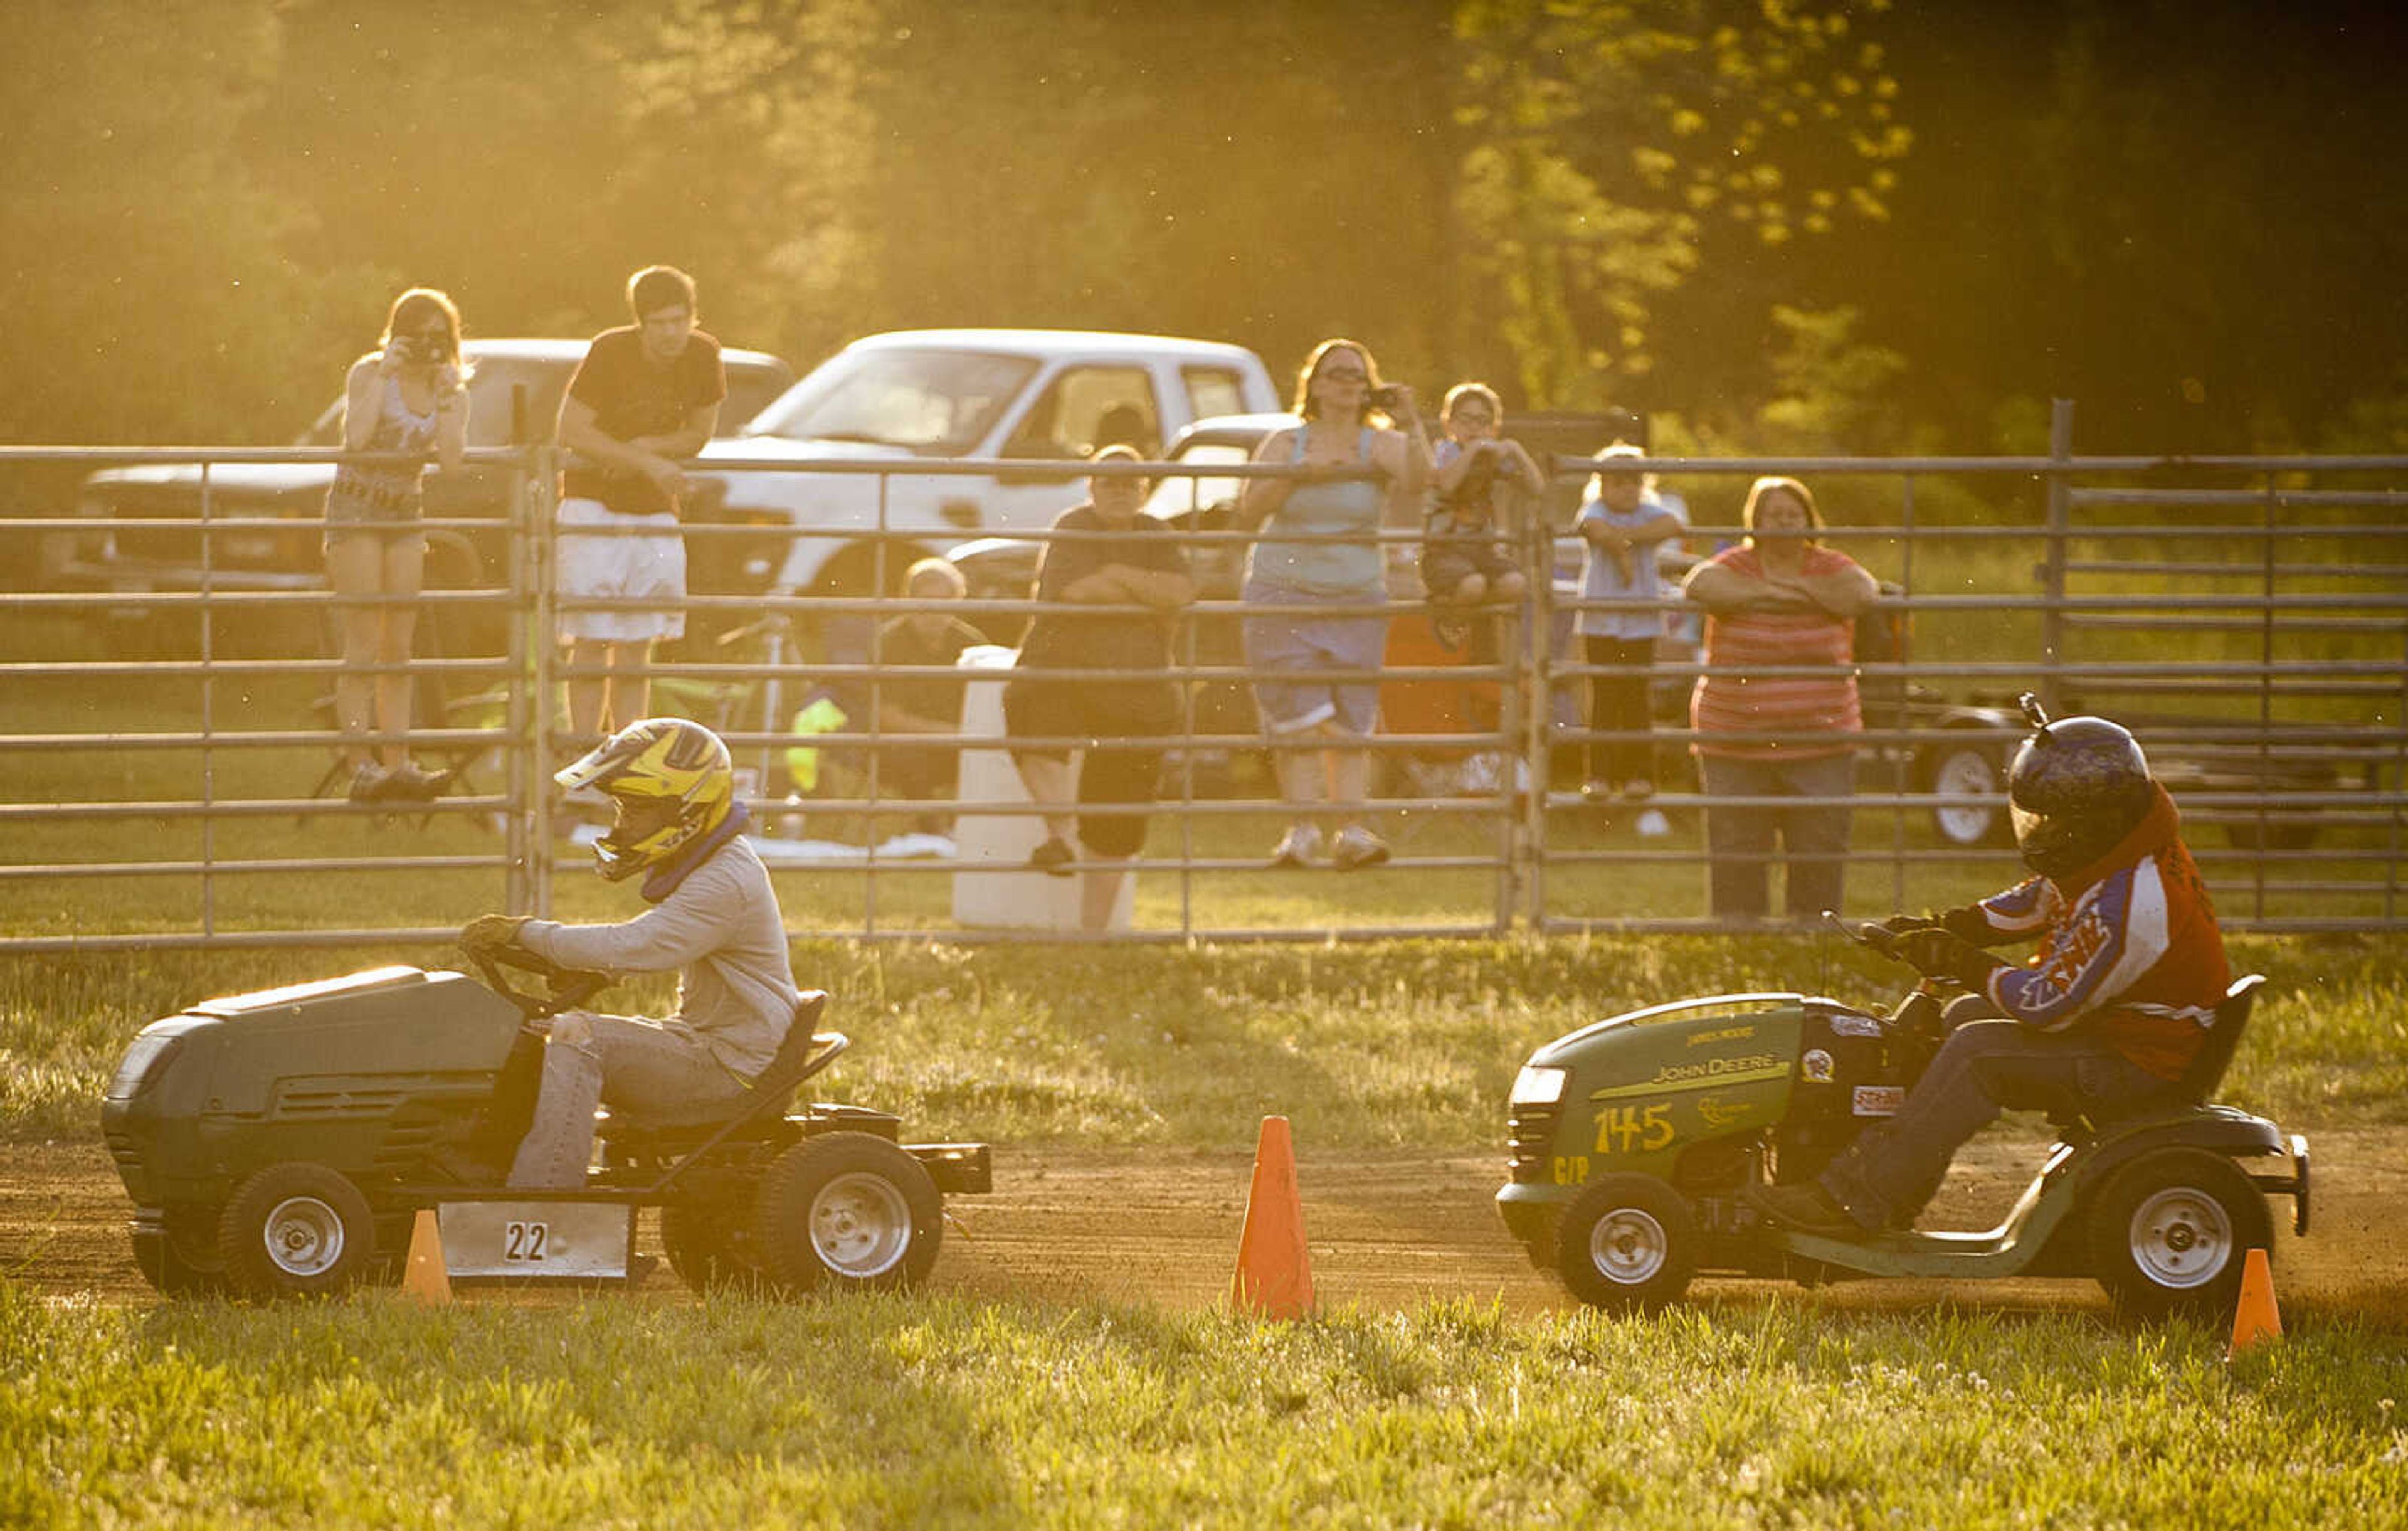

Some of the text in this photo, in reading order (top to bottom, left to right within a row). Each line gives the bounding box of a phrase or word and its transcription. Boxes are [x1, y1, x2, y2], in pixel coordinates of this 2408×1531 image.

[1652, 1054, 1774, 1084] JOHN DEERE
[1593, 1101, 1675, 1154] 145
[505, 1224, 545, 1261] 22
